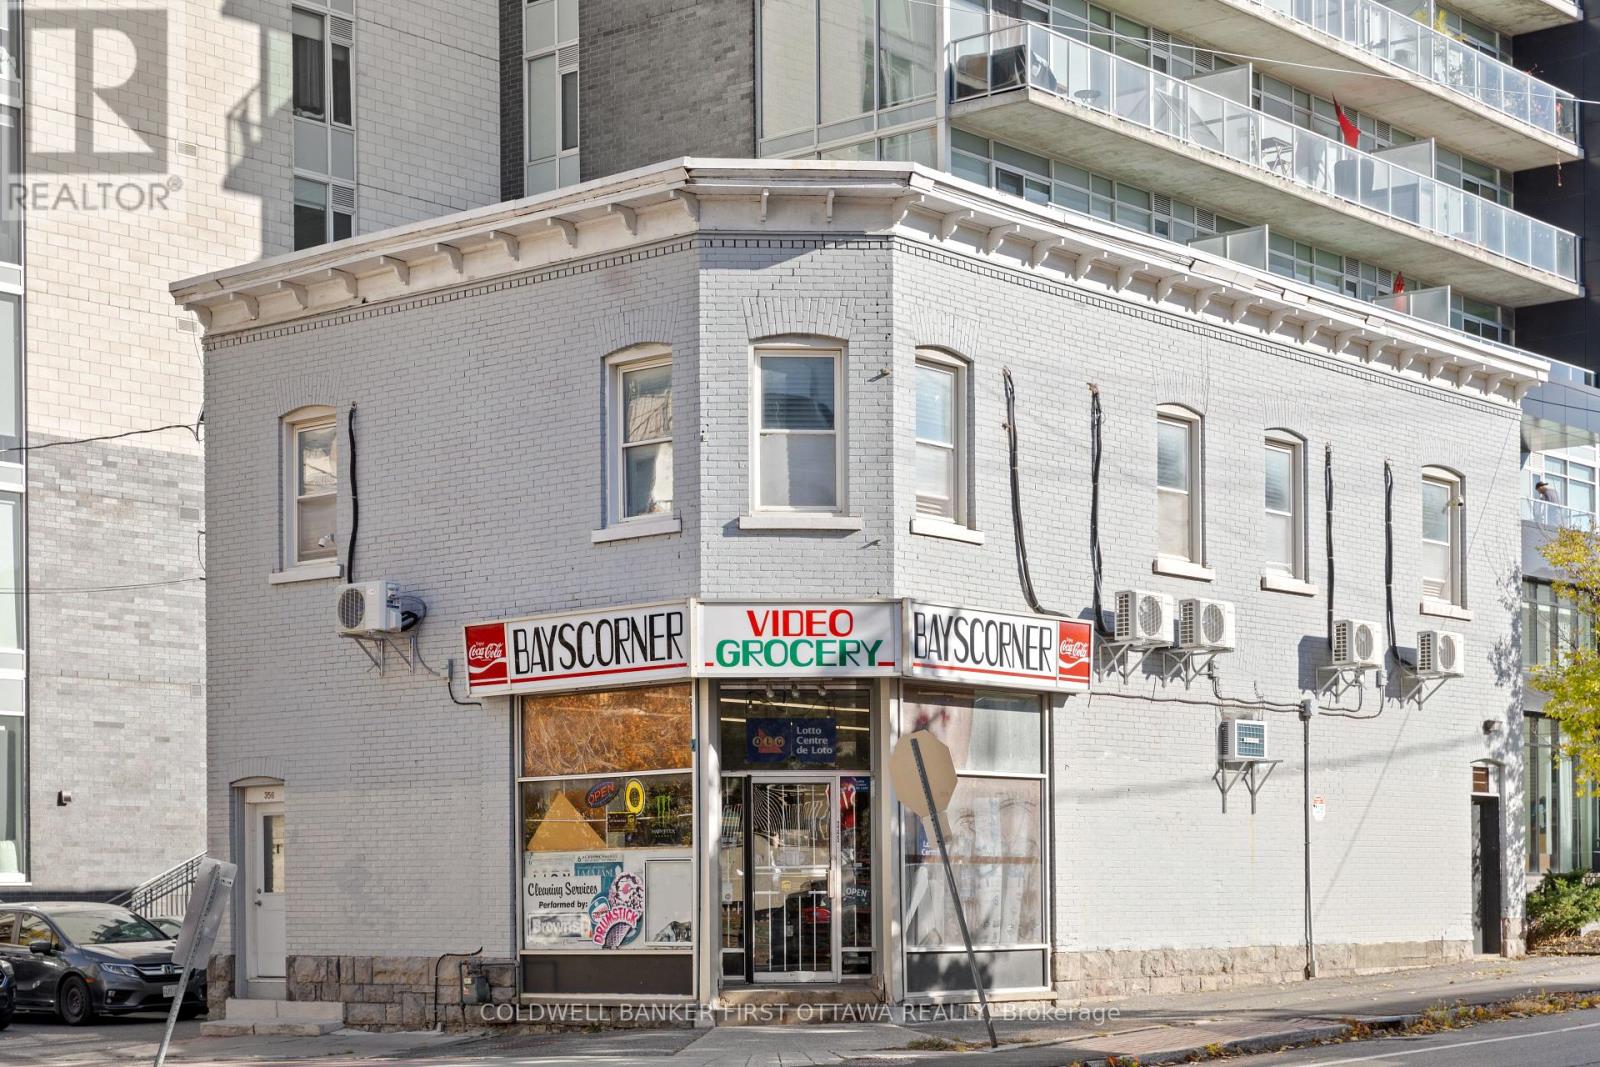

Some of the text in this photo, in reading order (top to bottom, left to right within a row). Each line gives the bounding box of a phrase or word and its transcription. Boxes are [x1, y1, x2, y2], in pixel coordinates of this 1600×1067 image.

[746, 609, 854, 637] VIDEO
[513, 611, 684, 675] BAYSCORNER
[914, 611, 1053, 672] BAYSCORNER
[715, 639, 883, 667] GROCERY
[796, 726, 822, 735] Lotto
[796, 736, 828, 745] Centre
[796, 745, 833, 754] de Loto
[587, 783, 617, 804] OPEN
[528, 881, 598, 898] Cleaning Services
[845, 887, 867, 897] OPEN
[538, 900, 588, 909] Performed by:
[594, 908, 639, 944] DRUMSTICK
